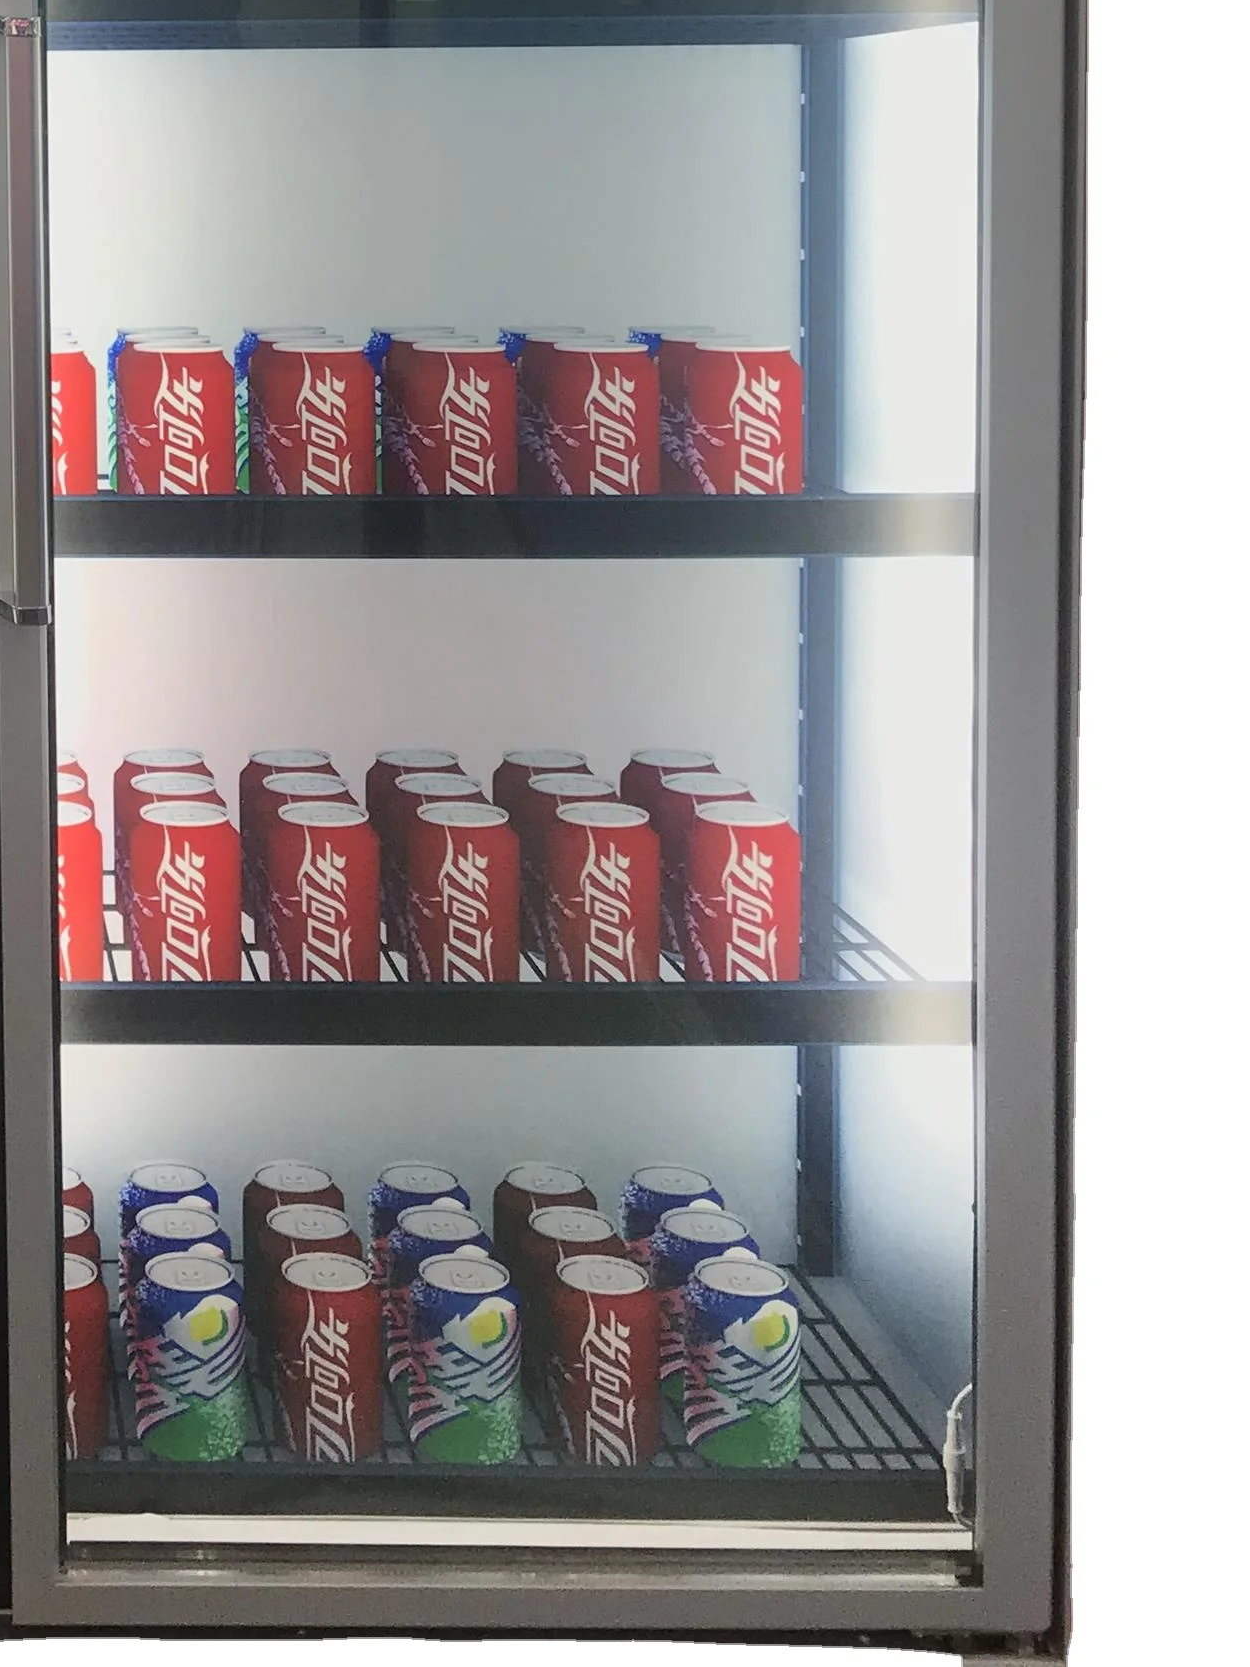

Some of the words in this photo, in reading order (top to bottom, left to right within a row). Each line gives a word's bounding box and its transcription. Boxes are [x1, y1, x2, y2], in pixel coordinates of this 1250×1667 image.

[301, 1288, 350, 1462] 可口可乐
[581, 1291, 632, 1466] 可口可乐
